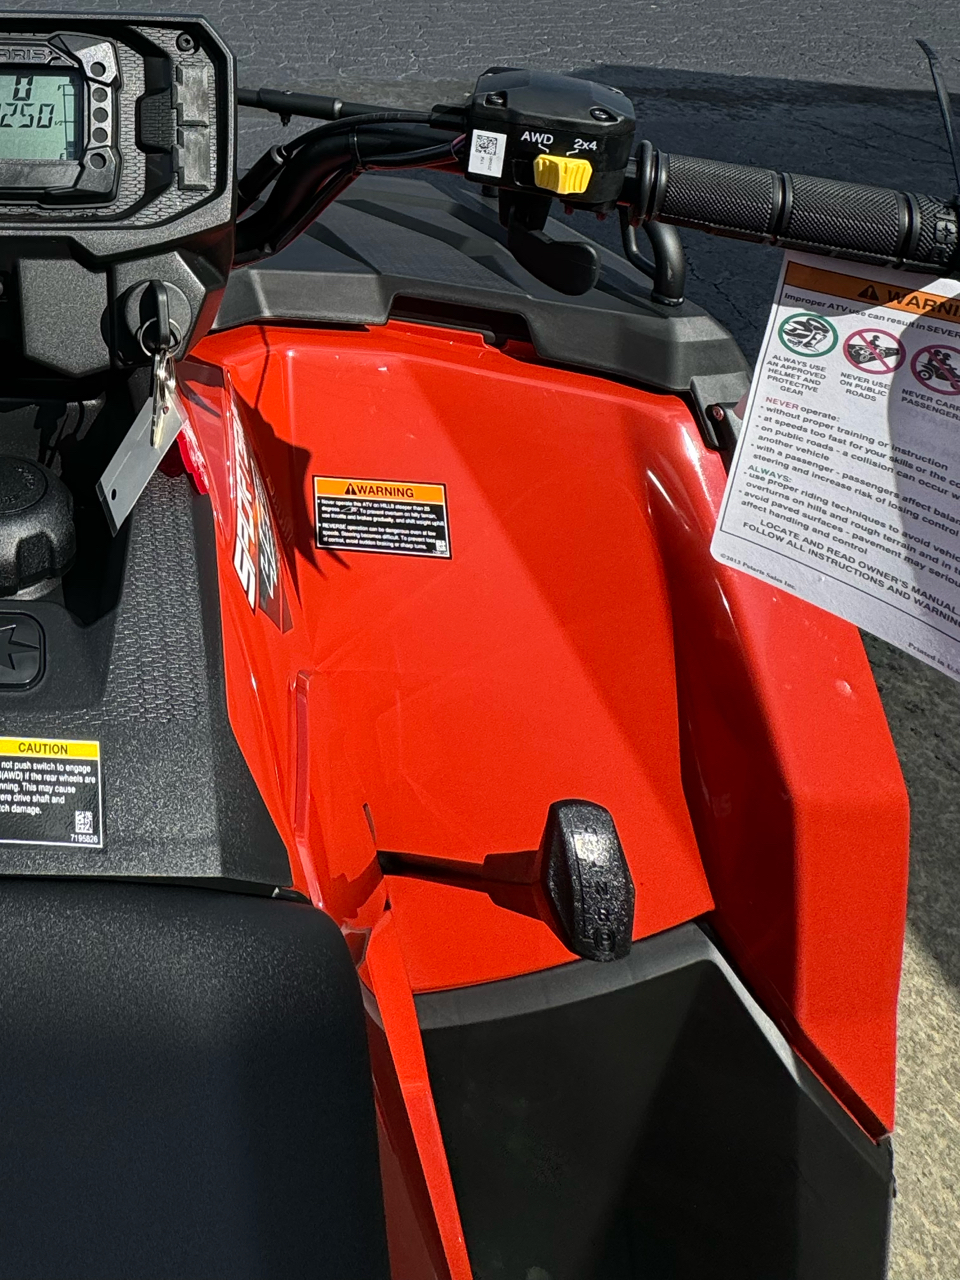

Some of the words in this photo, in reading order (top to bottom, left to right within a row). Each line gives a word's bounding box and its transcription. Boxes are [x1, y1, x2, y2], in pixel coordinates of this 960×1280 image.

[12, 75, 34, 101] 0
[521, 131, 554, 144] AWD
[573, 139, 597, 150] 2x4
[784, 292, 826, 306] Improper
[826, 302, 848, 311] ATV
[848, 308, 866, 316] use
[867, 313, 885, 321] can
[886, 317, 915, 327] result
[915, 322, 925, 330] in
[887, 290, 960, 316] WARNI
[772, 354, 806, 367] ALWAYS
[808, 363, 825, 372] USE
[779, 363, 826, 379] APPROVED
[766, 374, 817, 392] PROTECTIVE
[767, 367, 801, 380] HELMET
[802, 377, 821, 385] AND
[840, 371, 869, 383] NEVER
[871, 380, 890, 389] USE
[779, 385, 803, 396] GEAR
[839, 379, 852, 387] ON
[854, 383, 886, 396] PUBLIC
[845, 388, 876, 401] ROADS
[901, 388, 933, 402] NEVER
[765, 396, 799, 410] NEVER
[800, 406, 839, 421] operate:
[901, 396, 960, 420] PASSENGER
[766, 406, 800, 420] without
[802, 417, 834, 430] proper
[837, 426, 874, 444] training
[891, 444, 947, 470] instruction
[757, 435, 793, 448] another
[795, 446, 829, 460] vehicle
[774, 419, 807, 432] speeds
[810, 428, 825, 438] too
[828, 433, 846, 445] fast
[849, 440, 863, 450] for
[864, 447, 886, 458] your
[888, 456, 913, 469] skills
[915, 465, 927, 473] or
[929, 470, 946, 482] the
[774, 429, 803, 442] public
[806, 438, 833, 451] roads
[850, 454, 893, 472] collision
[895, 470, 915, 481] can
[918, 478, 948, 494] occur
[747, 464, 791, 482] ALWAYS:
[756, 444, 774, 453] with
[784, 453, 833, 472] passenger
[841, 472, 899, 498] passengers
[901, 496, 931, 512] affect
[356, 485, 413, 497] WARNING
[753, 453, 789, 469] steering
[791, 465, 809, 475] and
[811, 471, 851, 491] increase
[854, 488, 872, 499] risk
[875, 496, 886, 504] of
[887, 500, 919, 519] losing
[921, 516, 960, 536] control
[760, 519, 799, 540] LOCATE
[801, 537, 824, 549] AND
[826, 546, 855, 563] READ
[857, 560, 908, 588] OWNER'S
[742, 521, 784, 542] FOLLOW
[786, 539, 805, 552] ALL
[808, 548, 884, 587] INSTRUCTIONS
[886, 584, 910, 600] AND
[913, 596, 960, 626] WARNIN
[18, 742, 67, 754] CAUTION
[0, 760, 12, 768] not
[14, 761, 31, 770] push
[32, 762, 55, 770] switch
[56, 762, 64, 771] to
[65, 764, 91, 774] engage
